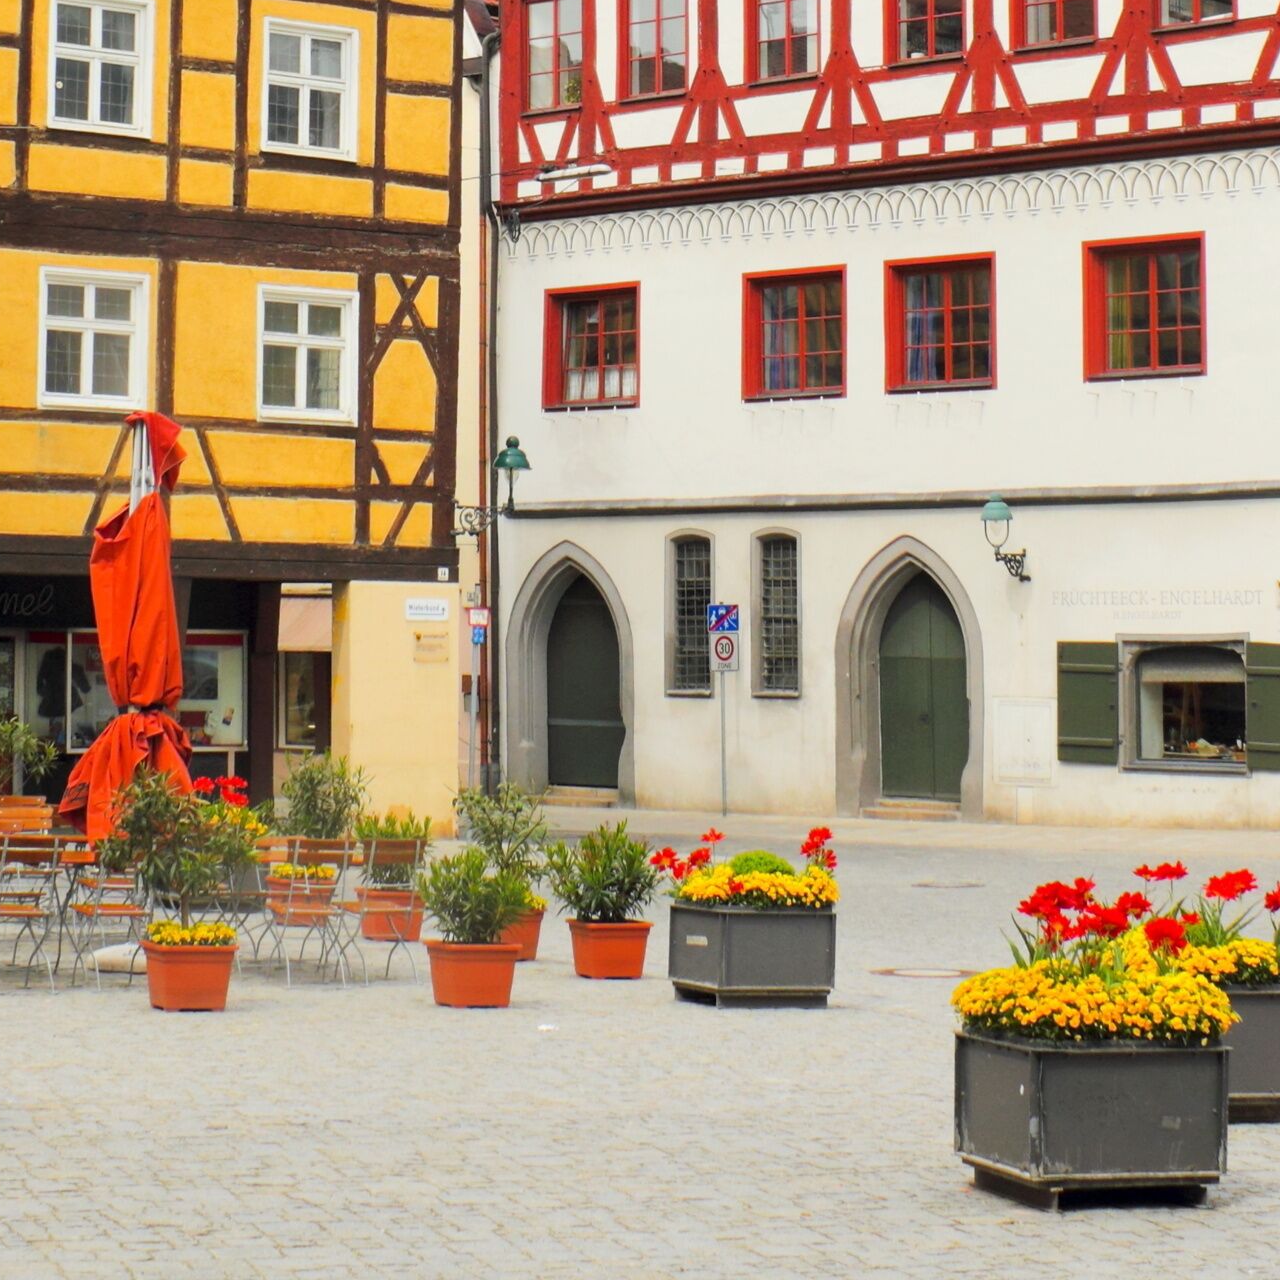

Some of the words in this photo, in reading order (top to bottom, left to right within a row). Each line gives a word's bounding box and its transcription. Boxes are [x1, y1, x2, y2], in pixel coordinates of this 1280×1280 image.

[1051, 588, 1149, 607] FRÜCHTEECK
[1160, 590, 1264, 606] ENGELHARDT
[719, 642, 730, 655] 30
